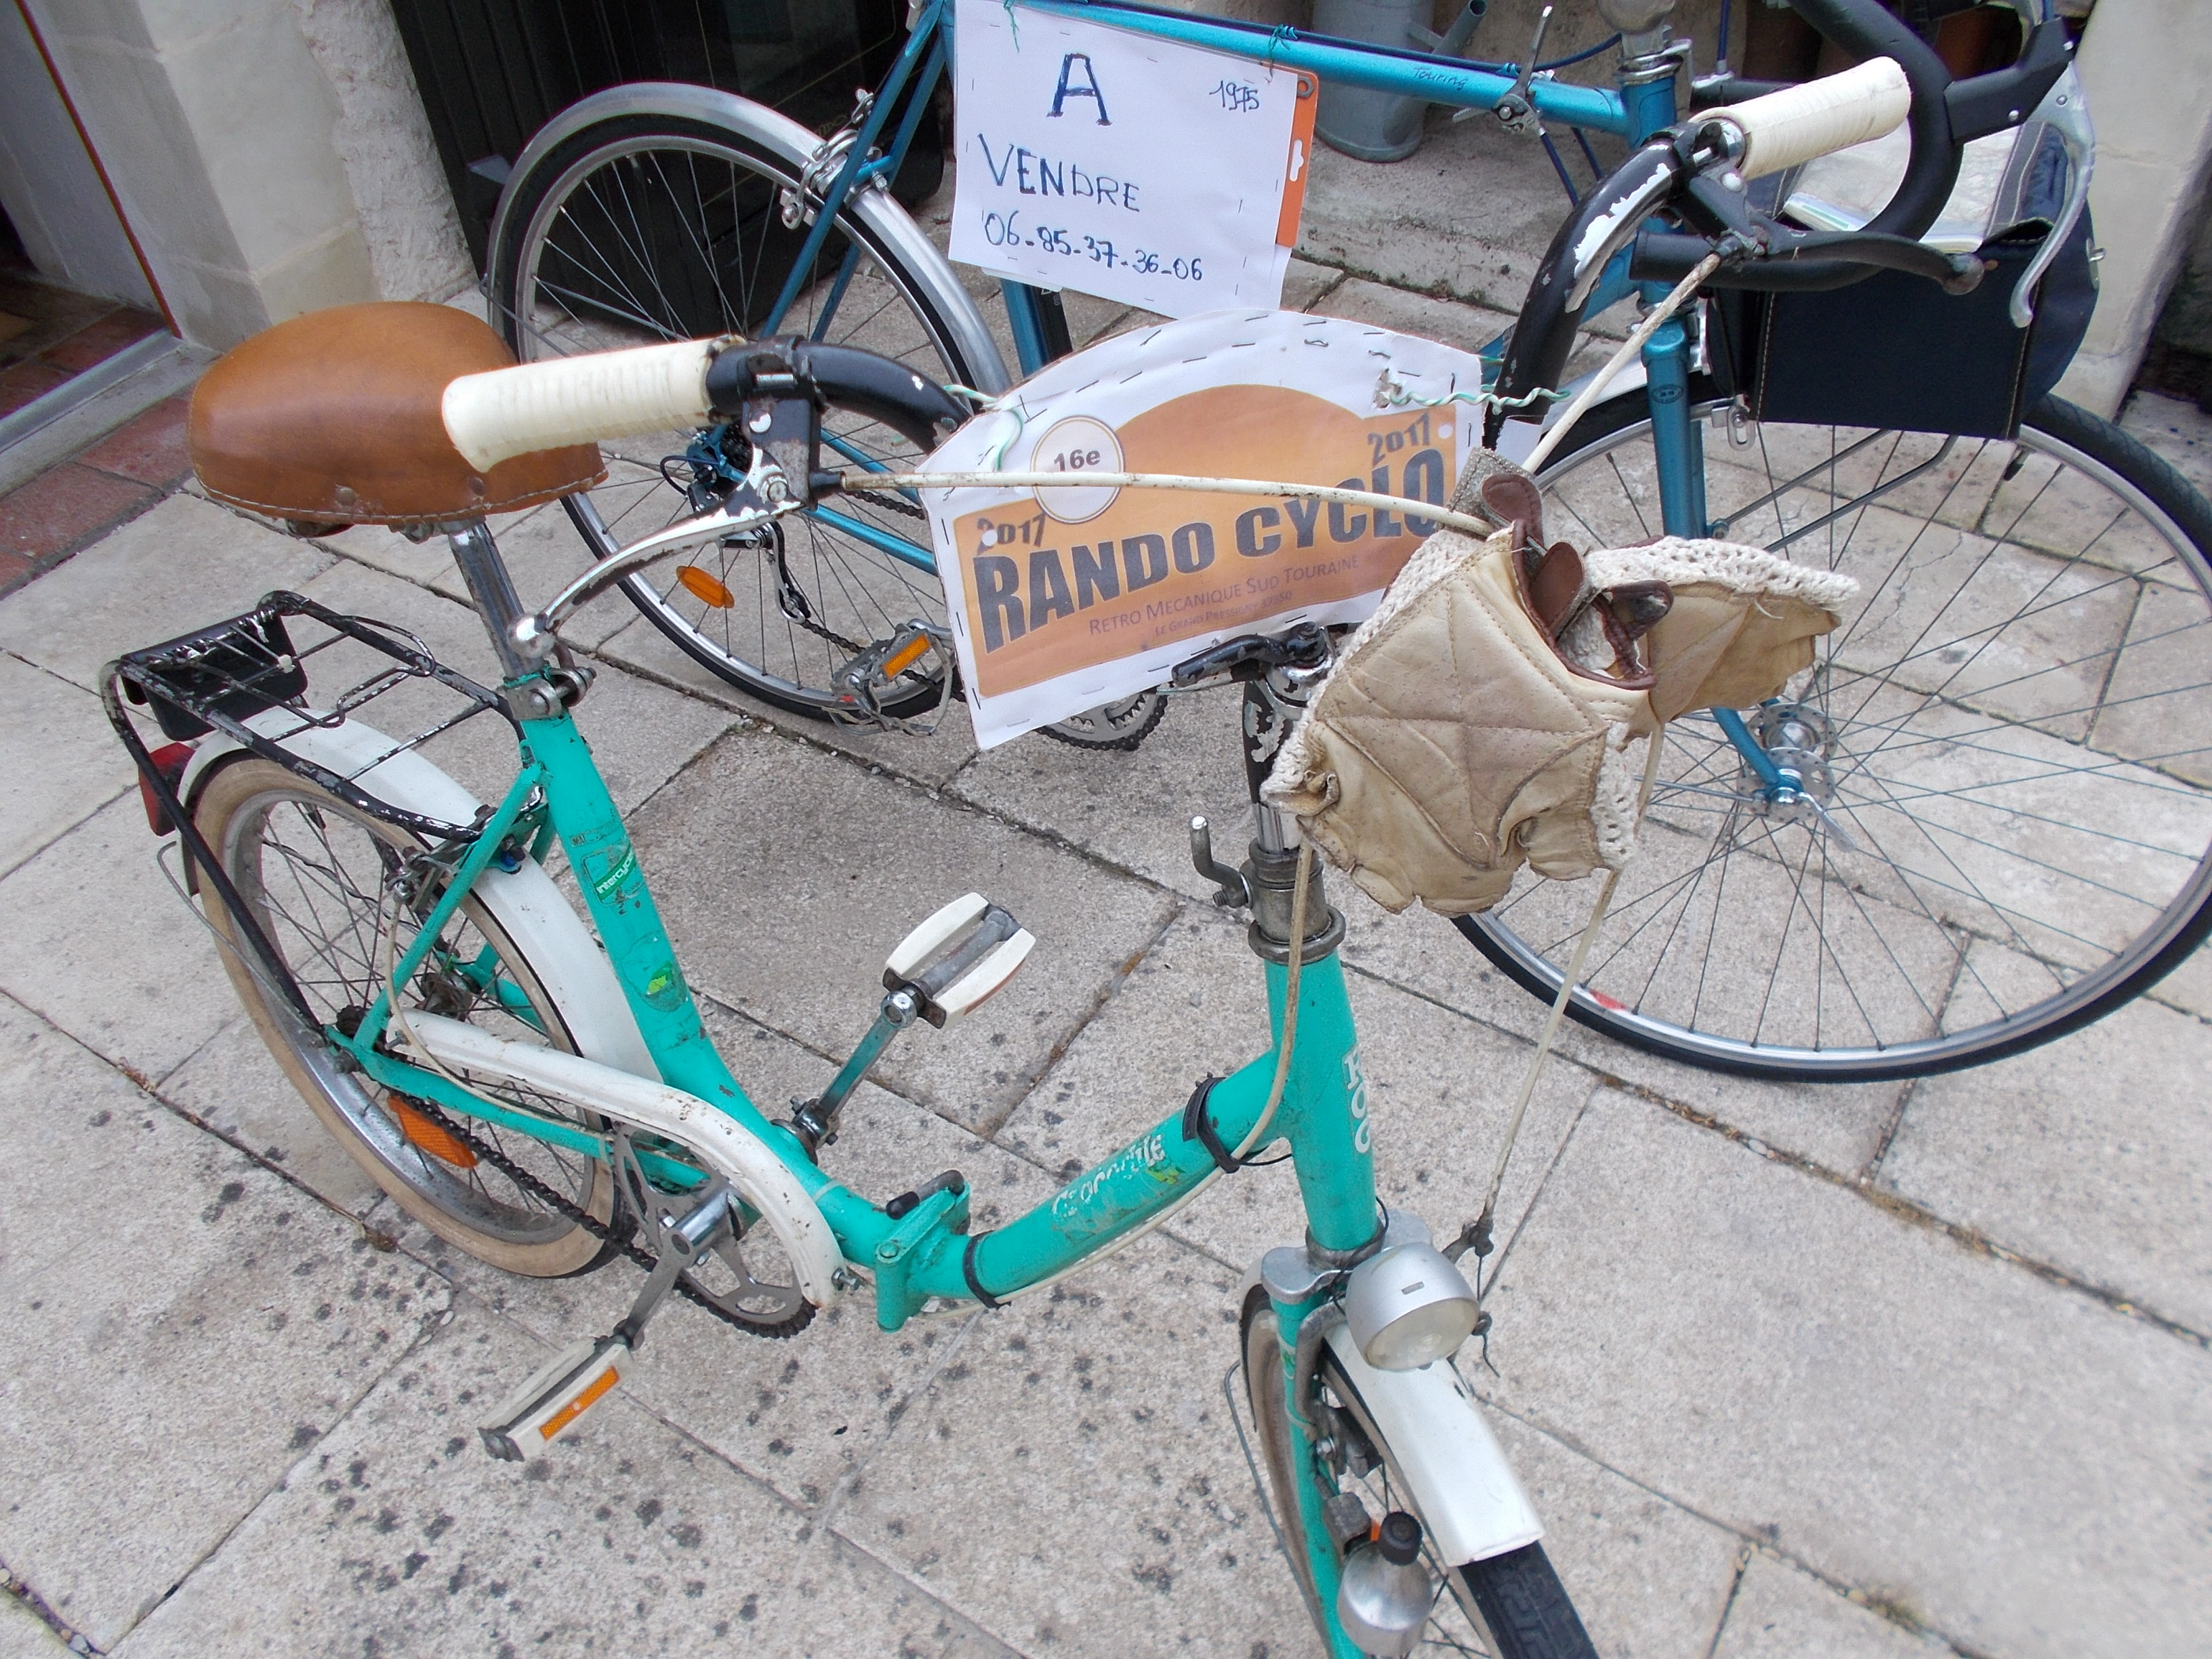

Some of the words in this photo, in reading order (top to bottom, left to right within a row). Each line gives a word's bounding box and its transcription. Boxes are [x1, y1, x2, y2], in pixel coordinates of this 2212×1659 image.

[1046, 53, 1112, 125] A
[1209, 80, 1260, 113] 1975
[978, 134, 1141, 212] VENDRE
[1054, 449, 1101, 472] 16e
[1367, 411, 1431, 466] 2017
[972, 521, 1216, 655] RANDO
[1235, 448, 1445, 558] CYCLO
[977, 512, 1047, 556] 2017
[1089, 609, 1141, 636] RETRO
[1147, 586, 1241, 619] MECANIQUE
[1246, 575, 1279, 594] SUD
[1283, 555, 1360, 584] TOURAINE
